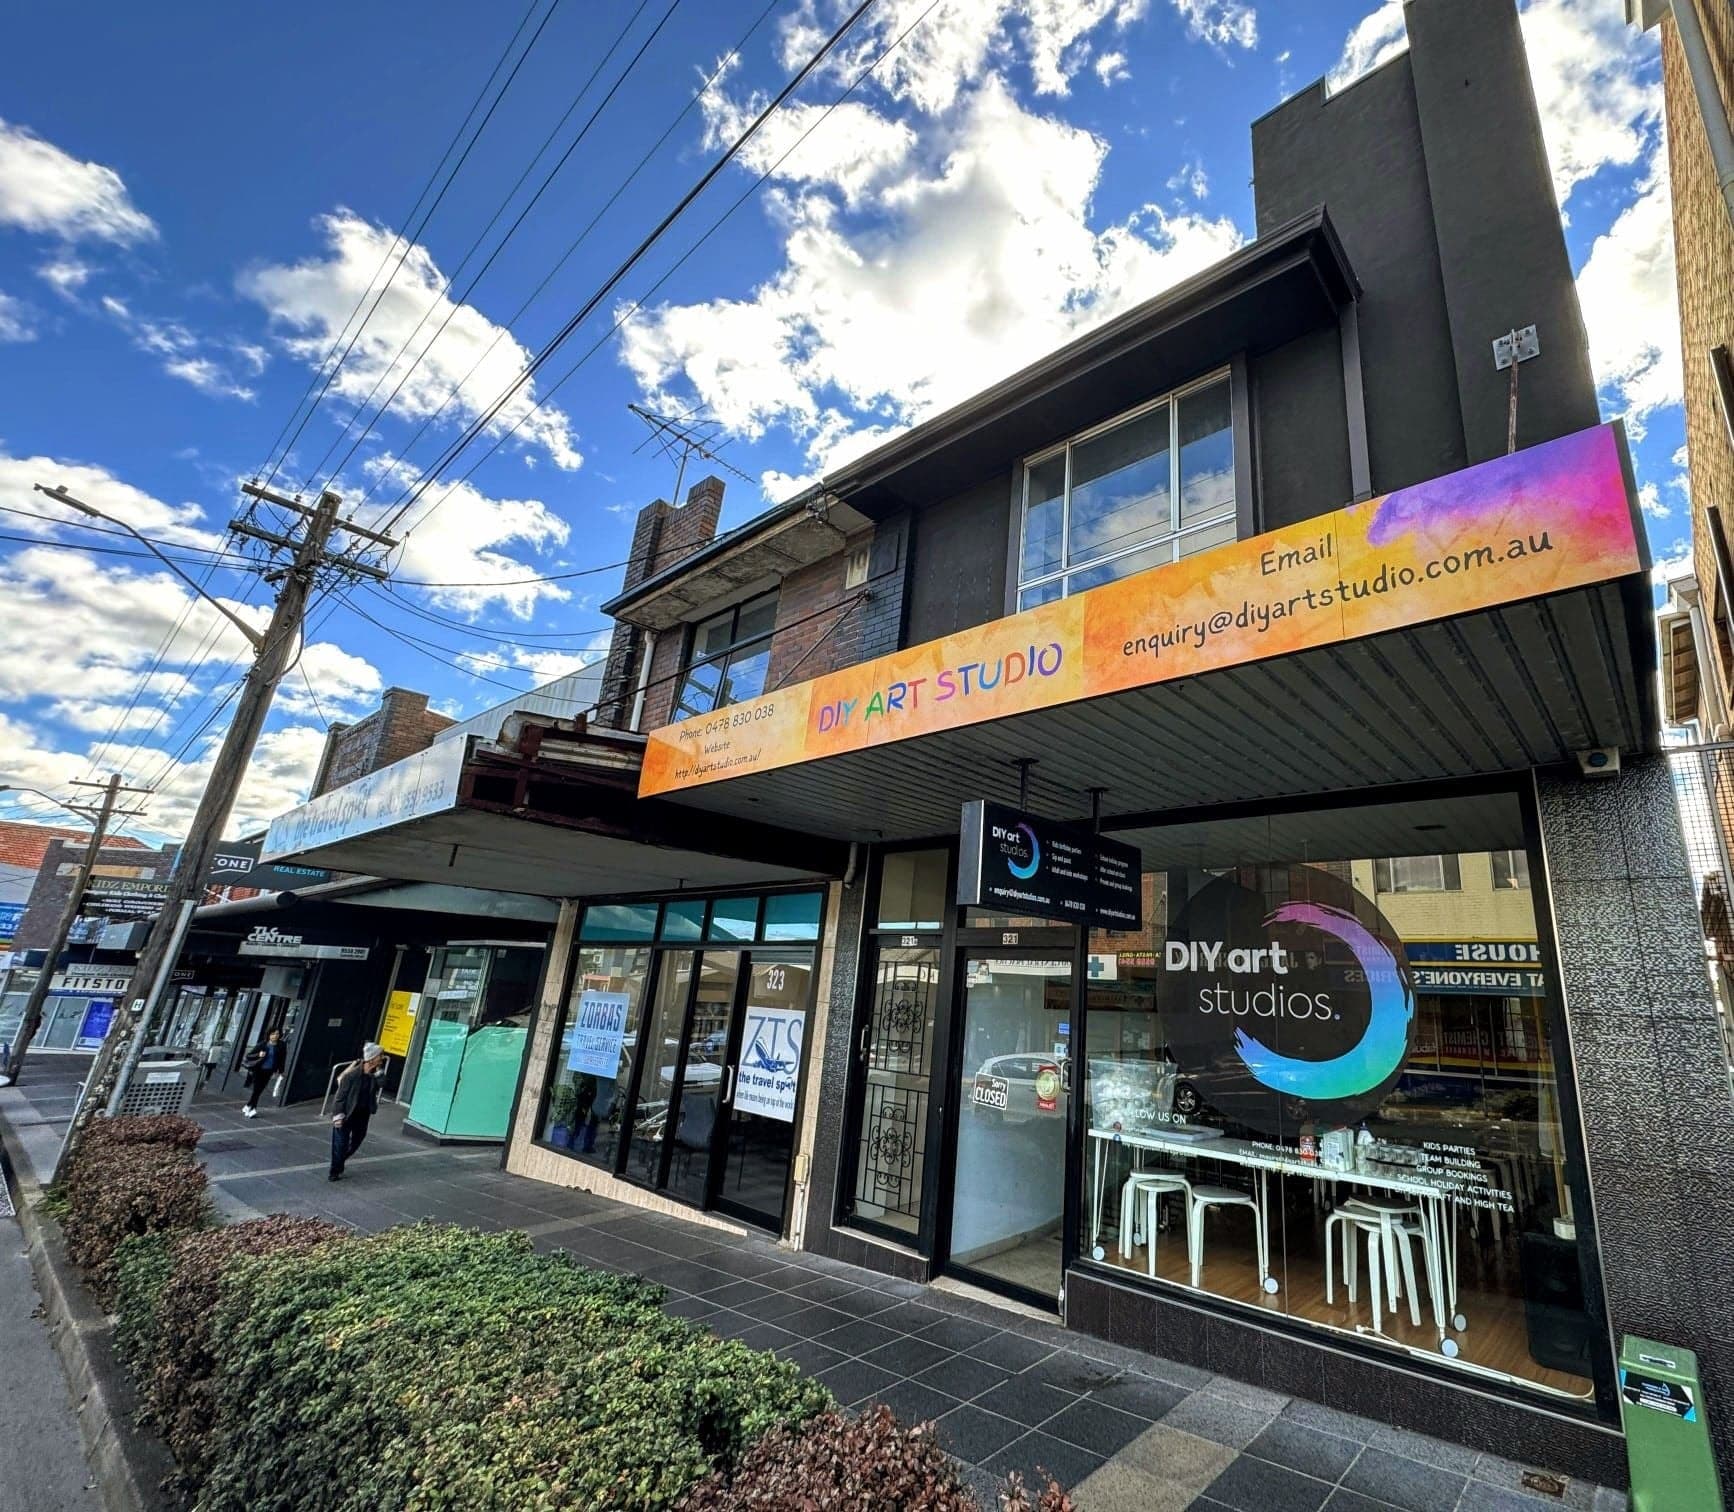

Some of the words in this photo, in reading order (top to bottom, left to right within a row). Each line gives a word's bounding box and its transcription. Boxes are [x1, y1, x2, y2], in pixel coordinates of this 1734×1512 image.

[1261, 533, 1332, 576] Email
[1123, 532, 1553, 658] enquiry@diyartstudio.com.au
[818, 698, 857, 734] DIY
[864, 678, 927, 721] ART
[934, 643, 1063, 702] STUDIO
[705, 718, 730, 735] 0478
[733, 711, 752, 728] 830
[754, 704, 775, 721] 038
[704, 741, 731, 755] Website
[992, 826, 1007, 840] DIY
[1007, 832, 1021, 844] art
[273, 865, 295, 874] REAL
[295, 868, 325, 877] ESTATE
[247, 933, 303, 944] CENTRE
[254, 926, 280, 936] TLC
[1003, 933, 1018, 944] 321
[1165, 941, 1224, 972] DIY
[1227, 941, 1289, 974] art
[62, 977, 126, 990] FITSTO
[766, 969, 786, 991] 323
[1199, 982, 1341, 1021] studios.
[581, 1001, 623, 1032] ZORBAS
[741, 1015, 802, 1075] ZTS
[738, 1071, 751, 1084] the
[752, 1074, 774, 1089] travel
[975, 1086, 1006, 1107] CLOSED
[1158, 1111, 1170, 1122] US
[1172, 1114, 1186, 1125] ON
[1252, 1141, 1275, 1151] PHONE:
[1275, 1144, 1293, 1154] 0478
[1423, 1142, 1441, 1151] KIDS
[1443, 1145, 1476, 1156] PARTIES
[1421, 1153, 1442, 1163] TEAM
[1444, 1156, 1481, 1169] BUILDING
[1416, 1165, 1444, 1176] GROUP
[1446, 1169, 1488, 1182] BOOKINGS
[1397, 1174, 1429, 1186] SCHOOL
[1430, 1179, 1465, 1192] HOLIDAY
[1467, 1186, 1513, 1200] ACTIVITIES
[1454, 1196, 1471, 1206] AND
[1474, 1198, 1495, 1209] HIGH
[1497, 1202, 1515, 1213] TEA
